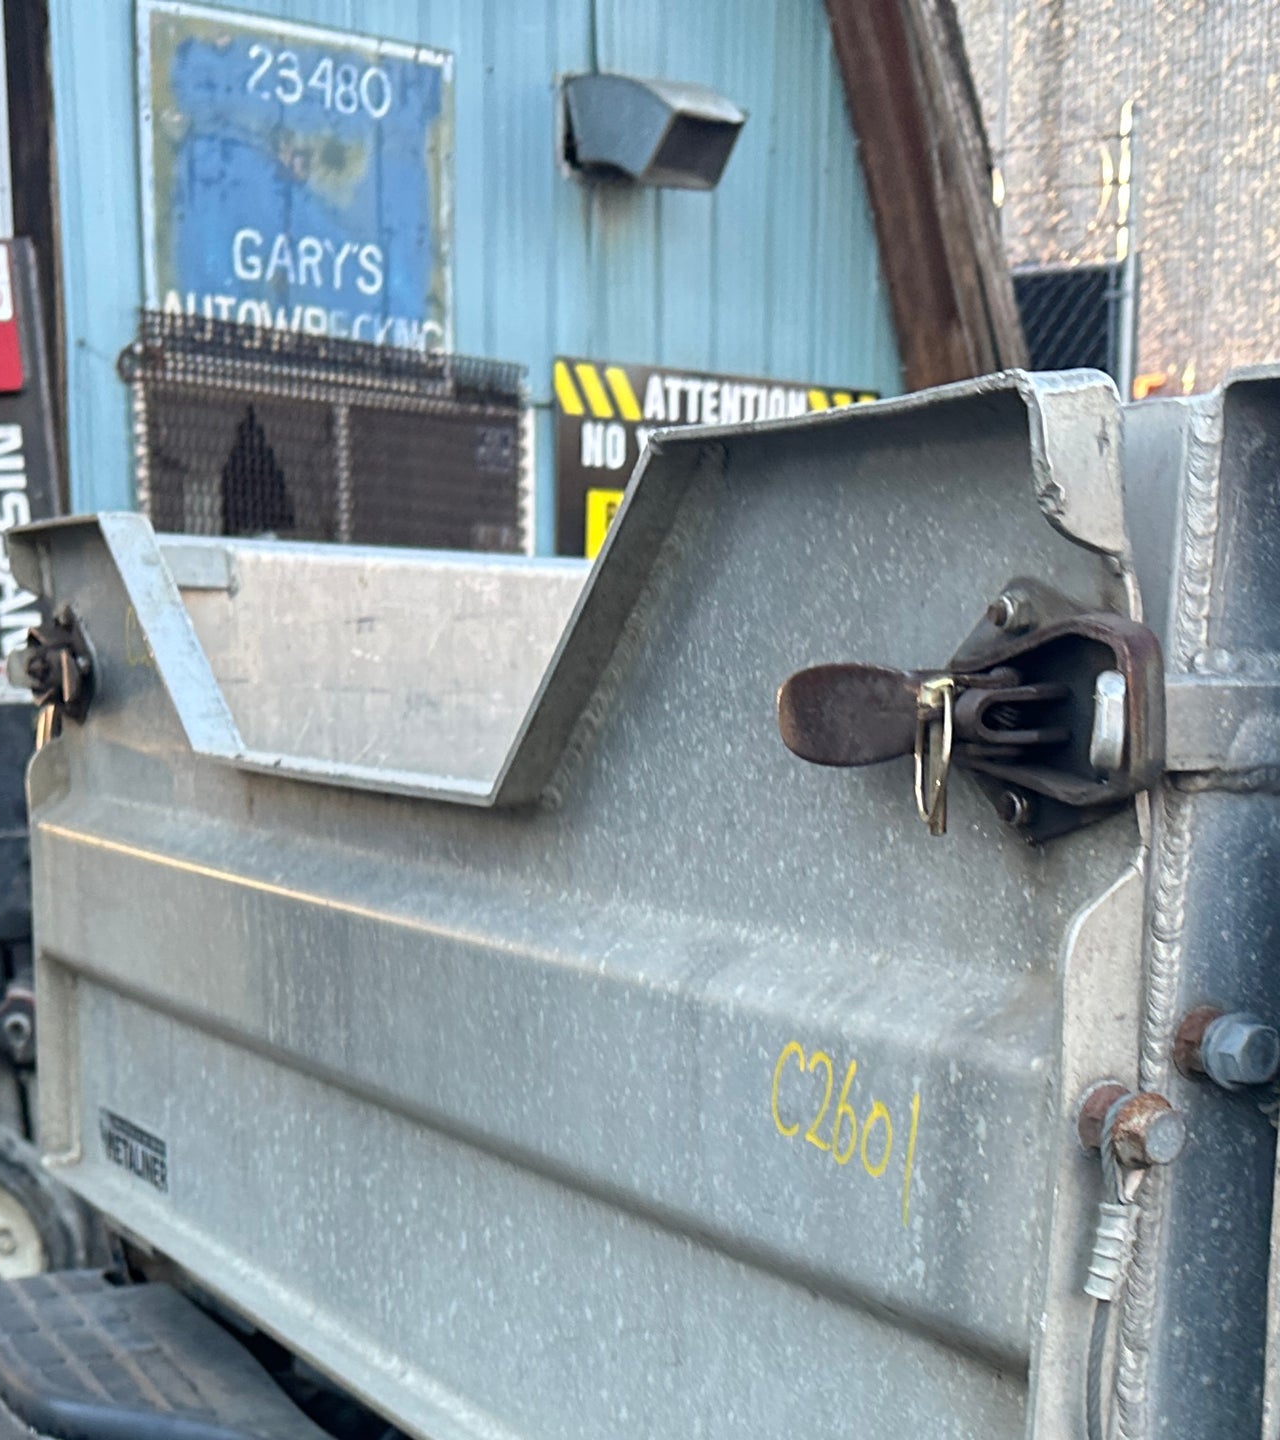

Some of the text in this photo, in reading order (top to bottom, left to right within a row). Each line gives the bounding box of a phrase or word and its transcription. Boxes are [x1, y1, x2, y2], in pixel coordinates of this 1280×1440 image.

[246, 43, 392, 118] 23480
[232, 228, 384, 296] GARY'S
[643, 373, 808, 424] ATTENTION
[581, 421, 626, 470] NO
[772, 1040, 920, 1229] C2601
